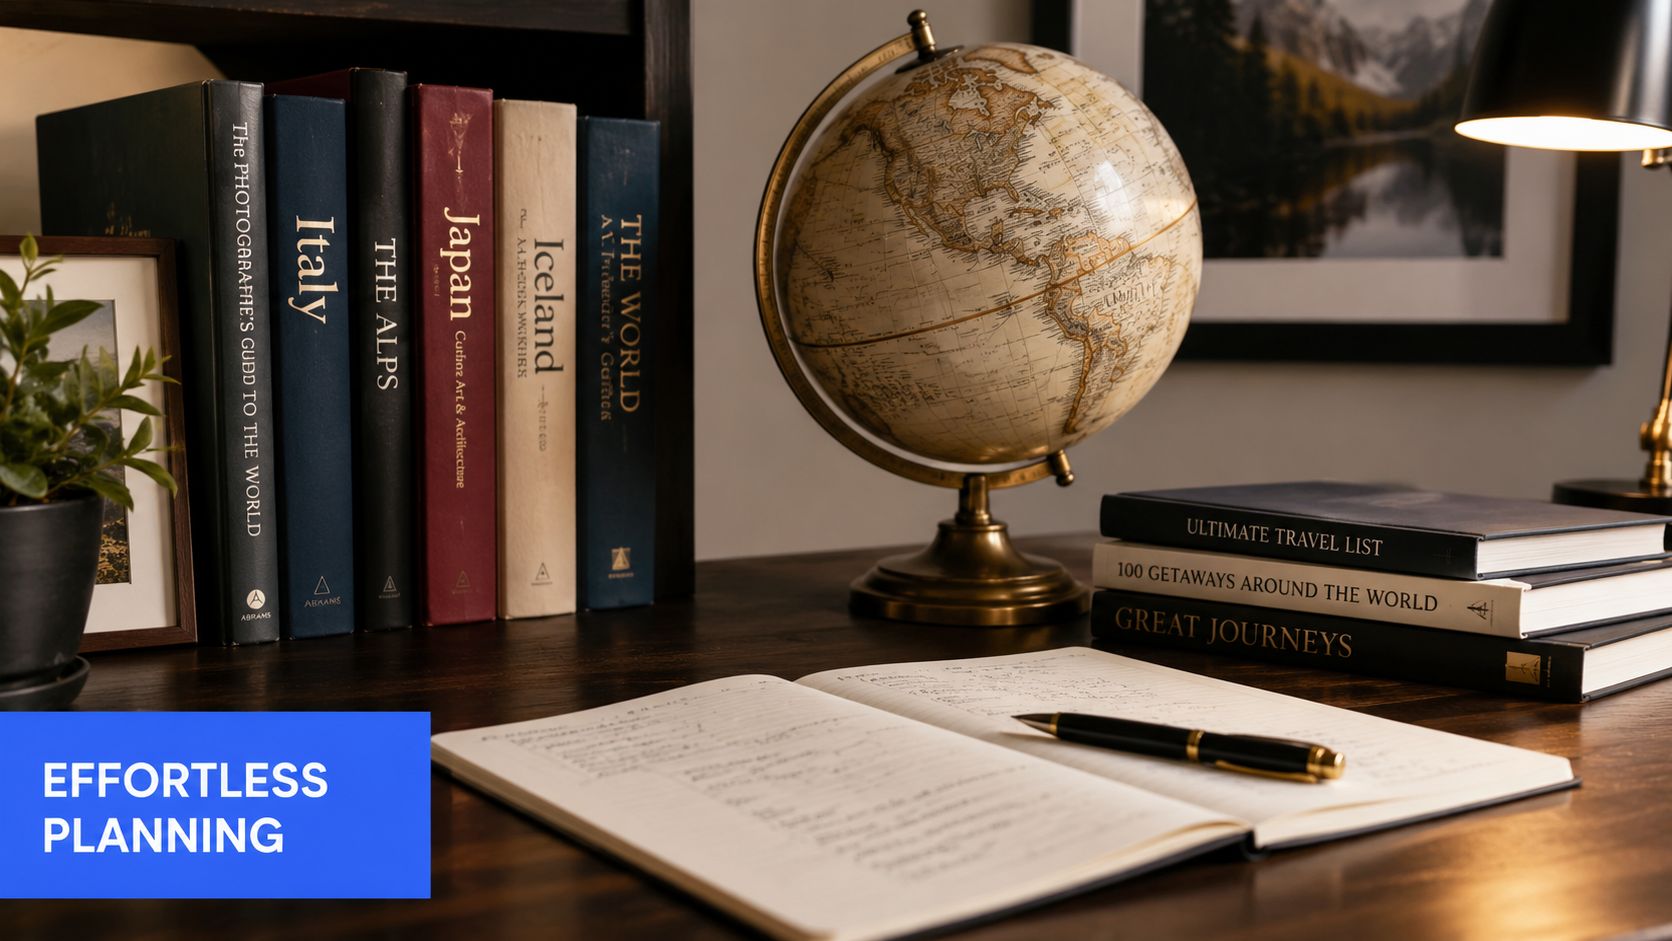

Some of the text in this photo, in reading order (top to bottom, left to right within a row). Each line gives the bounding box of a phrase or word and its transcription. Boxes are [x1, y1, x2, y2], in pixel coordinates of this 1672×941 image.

[287, 214, 340, 325] Italy
[439, 206, 481, 321] Japan
[374, 237, 399, 391] THE ALPS
[533, 237, 565, 375] Iceland
[619, 213, 643, 414] THE WORLD
[242, 389, 258, 417] TO
[455, 402, 467, 416] &
[243, 421, 259, 459] THE
[245, 464, 262, 537] WORLD
[1186, 517, 1384, 557] ULTIMATE TRAVEL LIST
[1117, 561, 1439, 612] 100 GETAWAYS AROUND THE WORLD
[1114, 606, 1354, 659] GREAT JOURNEYS
